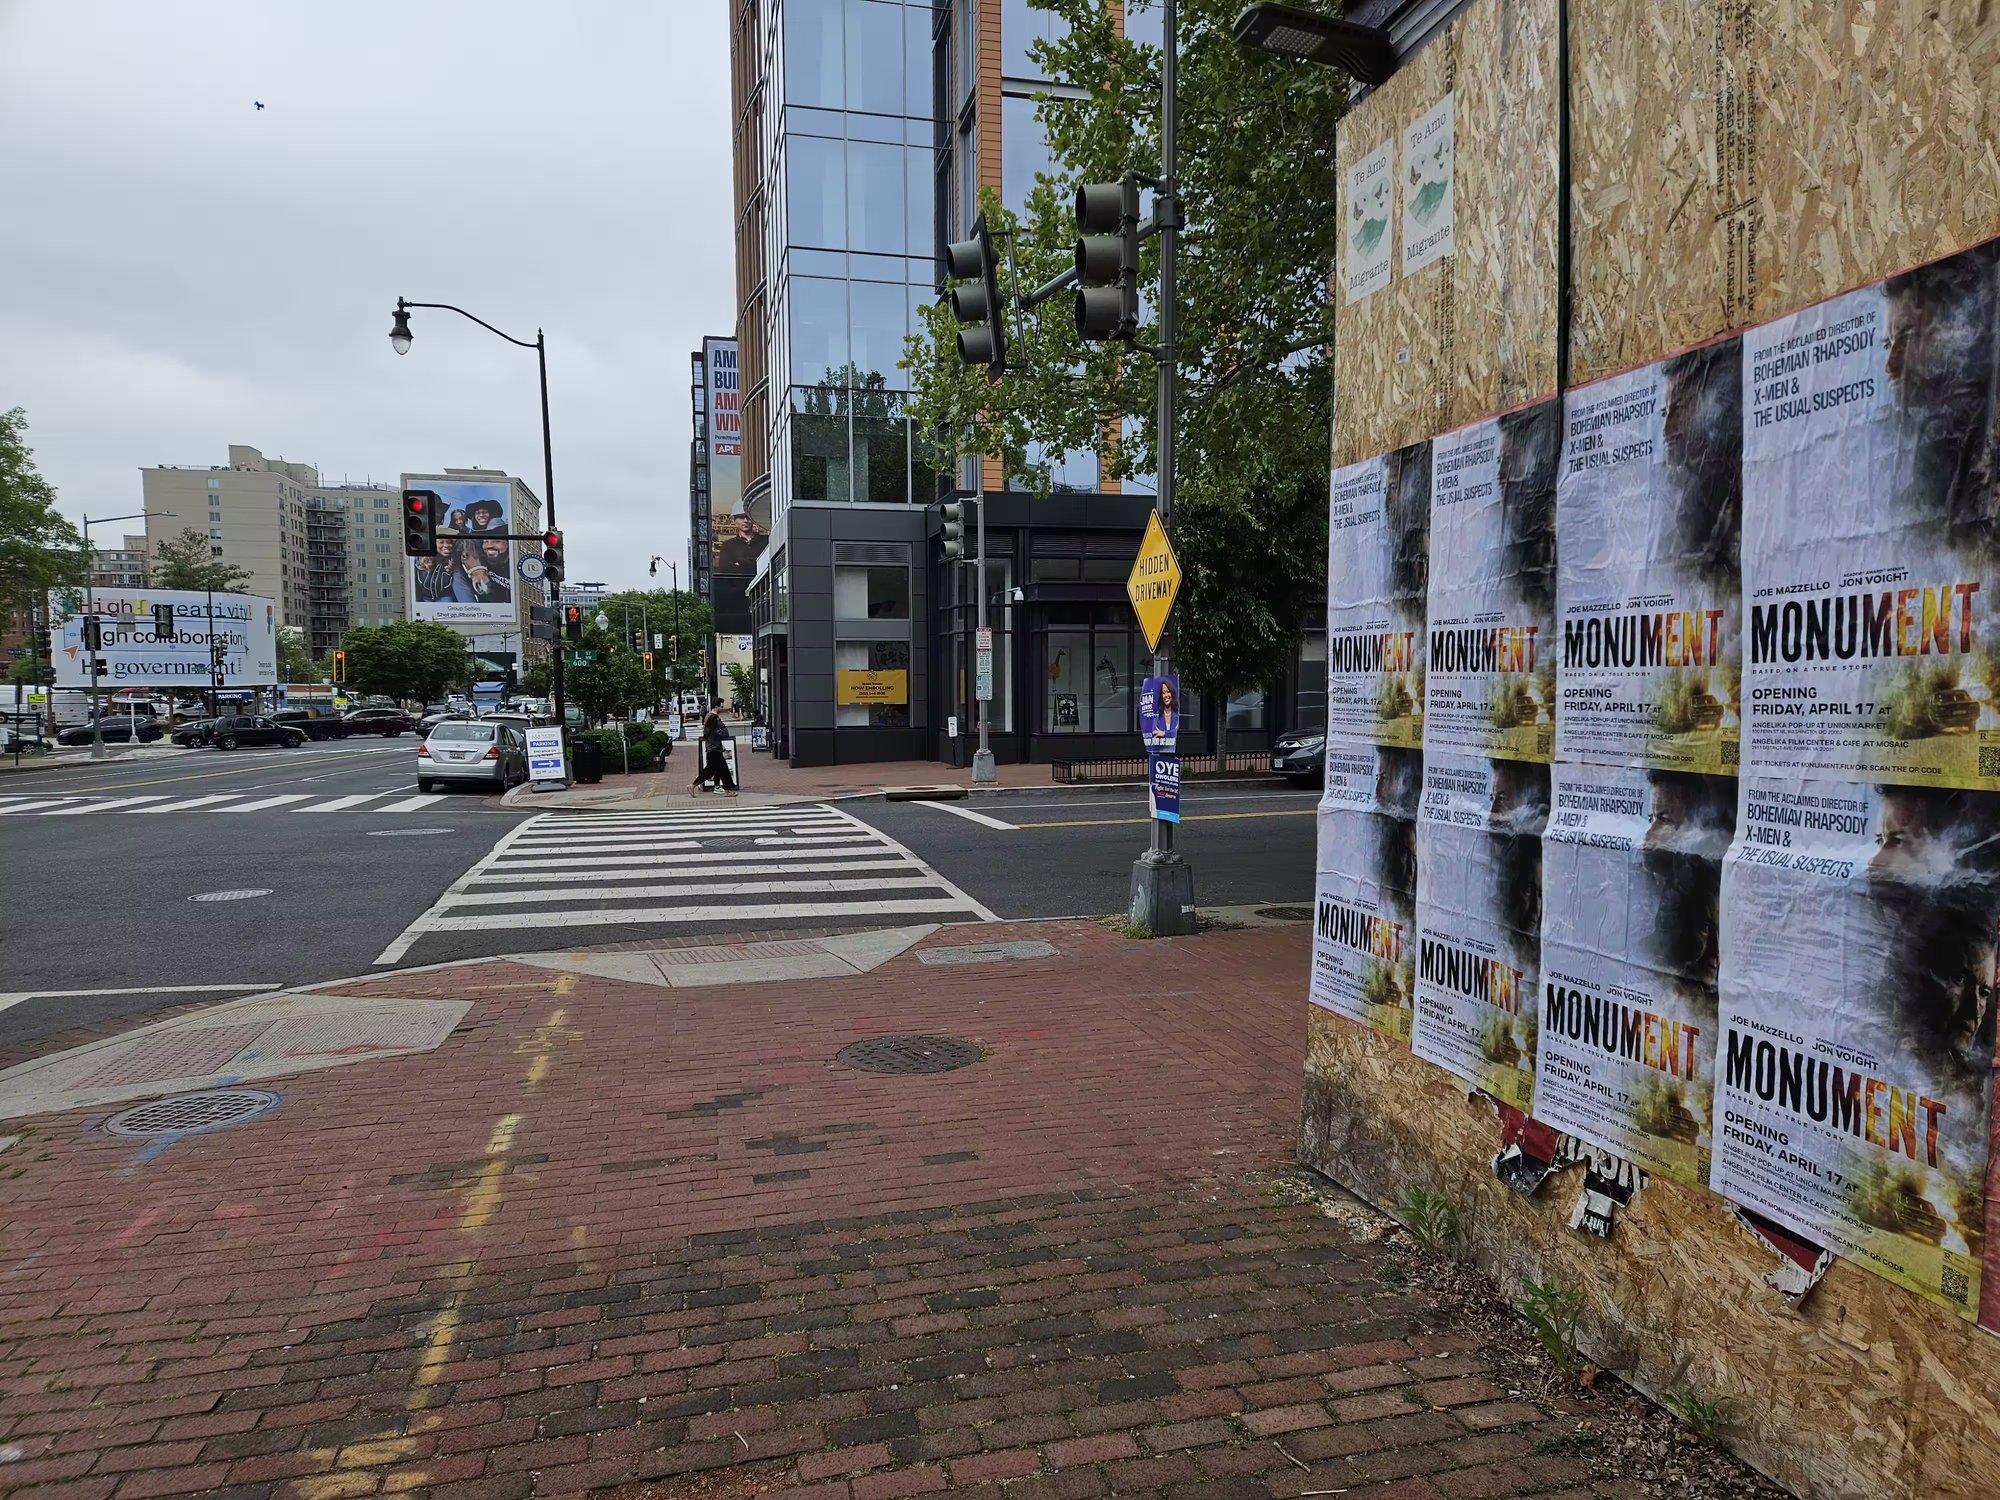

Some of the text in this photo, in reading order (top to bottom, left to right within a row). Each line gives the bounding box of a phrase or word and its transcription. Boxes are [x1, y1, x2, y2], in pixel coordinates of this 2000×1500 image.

[1410, 112, 1447, 150] Te Amo
[1354, 155, 1387, 186] Te Amo
[1406, 223, 1450, 262] Migrante
[1349, 258, 1390, 290] Migrante
[1754, 348, 1772, 362] FROM
[1829, 316, 1865, 338] DIRECTOR
[1866, 312, 1876, 326] OF
[714, 350, 738, 368] AM
[1754, 327, 1876, 384] BOHEMIAN RHAPSODY
[1754, 377, 1800, 406] X-MEN &
[1754, 378, 1874, 428] THE USUAL SUSPECTS
[1571, 398, 1656, 437] BOHEMIAN RHAPSODY
[1569, 440, 1652, 473] THE USUAL SUSPECTS
[1570, 434, 1604, 456] X-MEN &
[1140, 553, 1169, 576] HIDDEN
[1136, 578, 1172, 602] DRIVEWAY
[1753, 572, 1909, 598] JOE MAZZELLO JON VOIGHT
[1582, 602, 1622, 612] MAZZELLO
[1626, 600, 1642, 608] JON
[1644, 598, 1675, 608] VOIGHT
[1751, 582, 1980, 664] MONUMENT
[1333, 632, 1414, 672] MONUMENT
[1431, 626, 1538, 672] MONUMENT
[1564, 610, 1724, 668] MONUMENT
[575, 651, 582, 660] L
[1333, 687, 1358, 695] OPENING
[1333, 696, 1353, 705] FRIDAY,
[1430, 689, 1462, 698] OPENING
[1430, 700, 1488, 711] FRIDAY, APRIL 17
[1564, 688, 1612, 698] OPENING
[1752, 687, 1817, 700] OPENING
[1564, 702, 1651, 713] FRIDAY, APRIL 17
[1752, 704, 1892, 716] FRIDAY, APRIL 17 AT
[1156, 760, 1179, 777] OYE
[1558, 794, 1644, 816] BOHEMIAN RHAPSODY
[1748, 789, 1869, 813] FROM THE ACCLAIMED DIRECTOR OF
[1555, 812, 1588, 828] X-MEN &
[1748, 803, 1868, 835] BOHEMIAN RHAPSODY
[1550, 829, 1632, 852] THE USUAL SUSPECTS
[1746, 824, 1792, 848] X-MEN &
[1737, 846, 1854, 878] THE USUAL SUSPECTS
[1318, 900, 1403, 963] MONUMENT
[1316, 960, 1338, 974] FRIDAY,
[1338, 968, 1356, 981] APRIL
[1317, 950, 1344, 966] OPENING
[1420, 938, 1523, 1016] MONUMENT
[1549, 971, 1654, 1006] JOE MAZZELLO JON VOIGHT
[1420, 996, 1453, 1015] OPENING
[1420, 1006, 1480, 1038] FRIDAY, APRIL 17
[1546, 982, 1700, 1082] MONUMENT
[1730, 1014, 1879, 1070] JOE MAZZELLO JON VOIGHT
[1545, 1050, 1591, 1076] OPENING
[1544, 1063, 1629, 1104] FRIDAY, APRIL 17
[1726, 1028, 1947, 1168] MONUMENT
[1724, 1110, 1789, 1145] OPENING
[1723, 1142, 1852, 1206] ANGELIKA POP-UP AT UNION MARKET
[1724, 1125, 1859, 1194] FRIDAY, APRIL 17 AT
